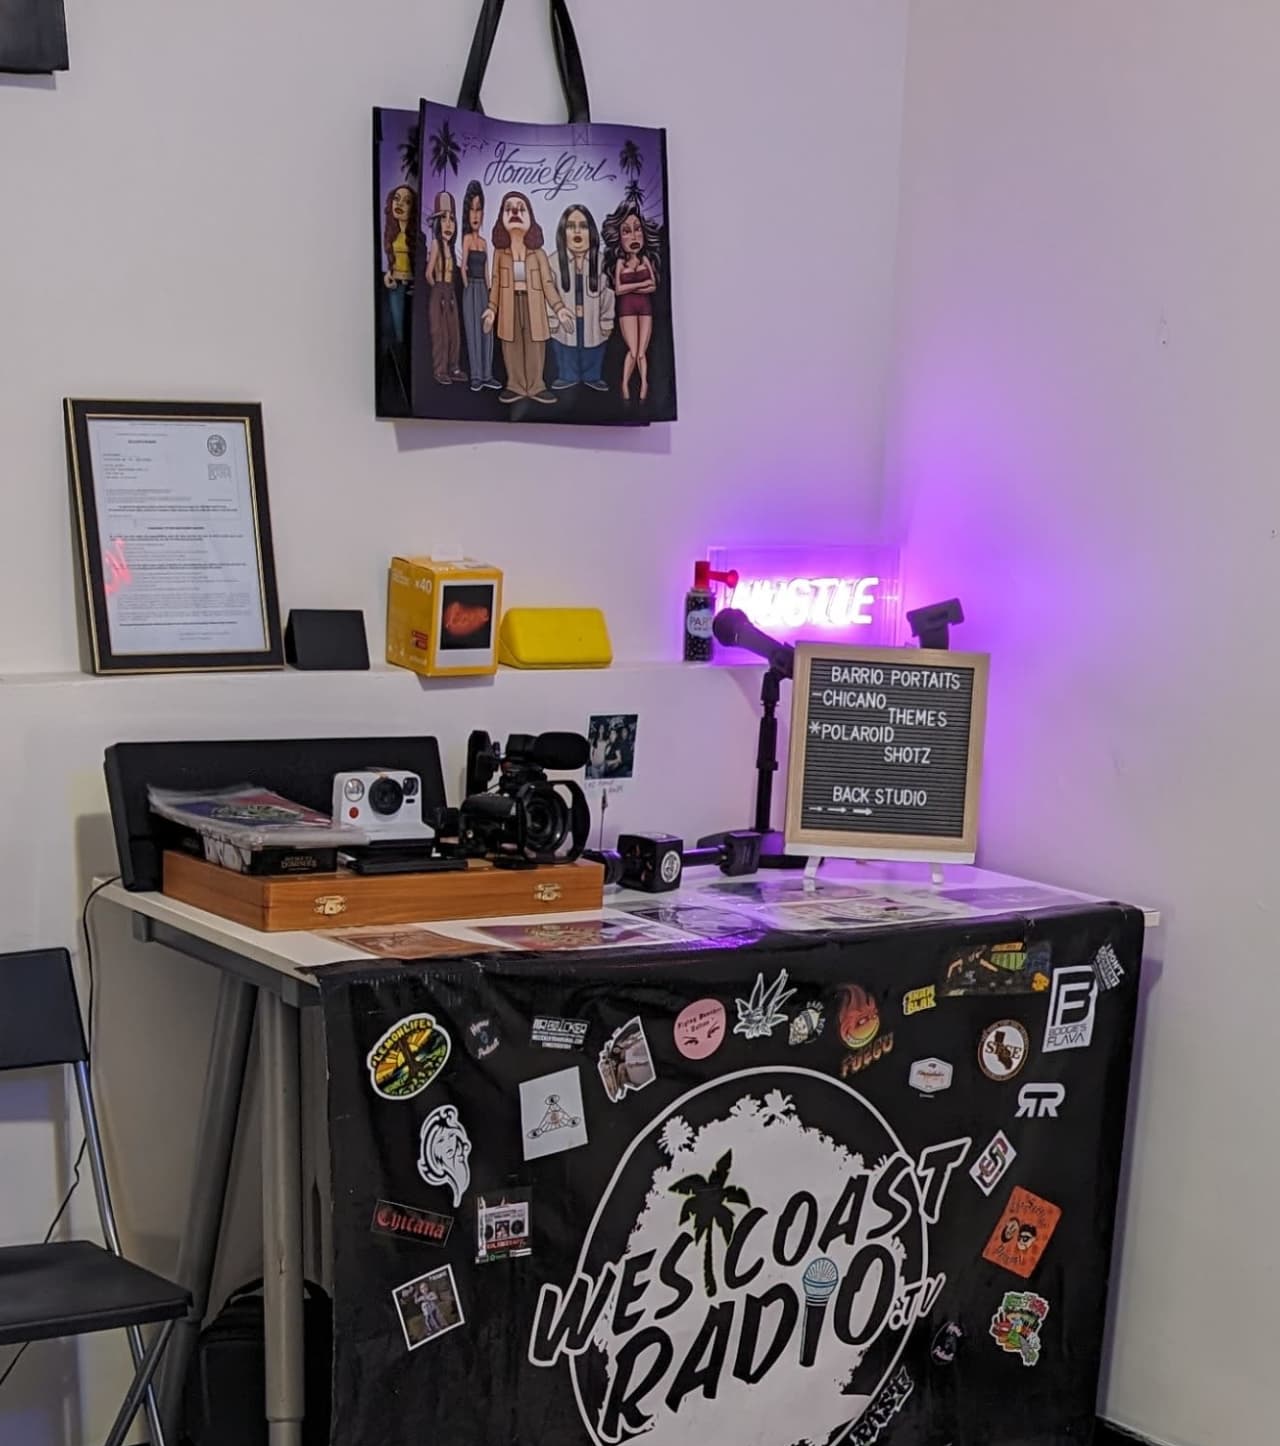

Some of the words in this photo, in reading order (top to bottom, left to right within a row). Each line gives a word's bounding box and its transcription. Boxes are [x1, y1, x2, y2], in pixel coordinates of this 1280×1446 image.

[831, 666, 884, 685] BARRIO
[890, 670, 961, 690] PORTAITS
[888, 707, 948, 727] THEMES
[883, 746, 932, 765] SHOTZ
[832, 786, 871, 804] BACK
[874, 788, 928, 807] STUDIO
